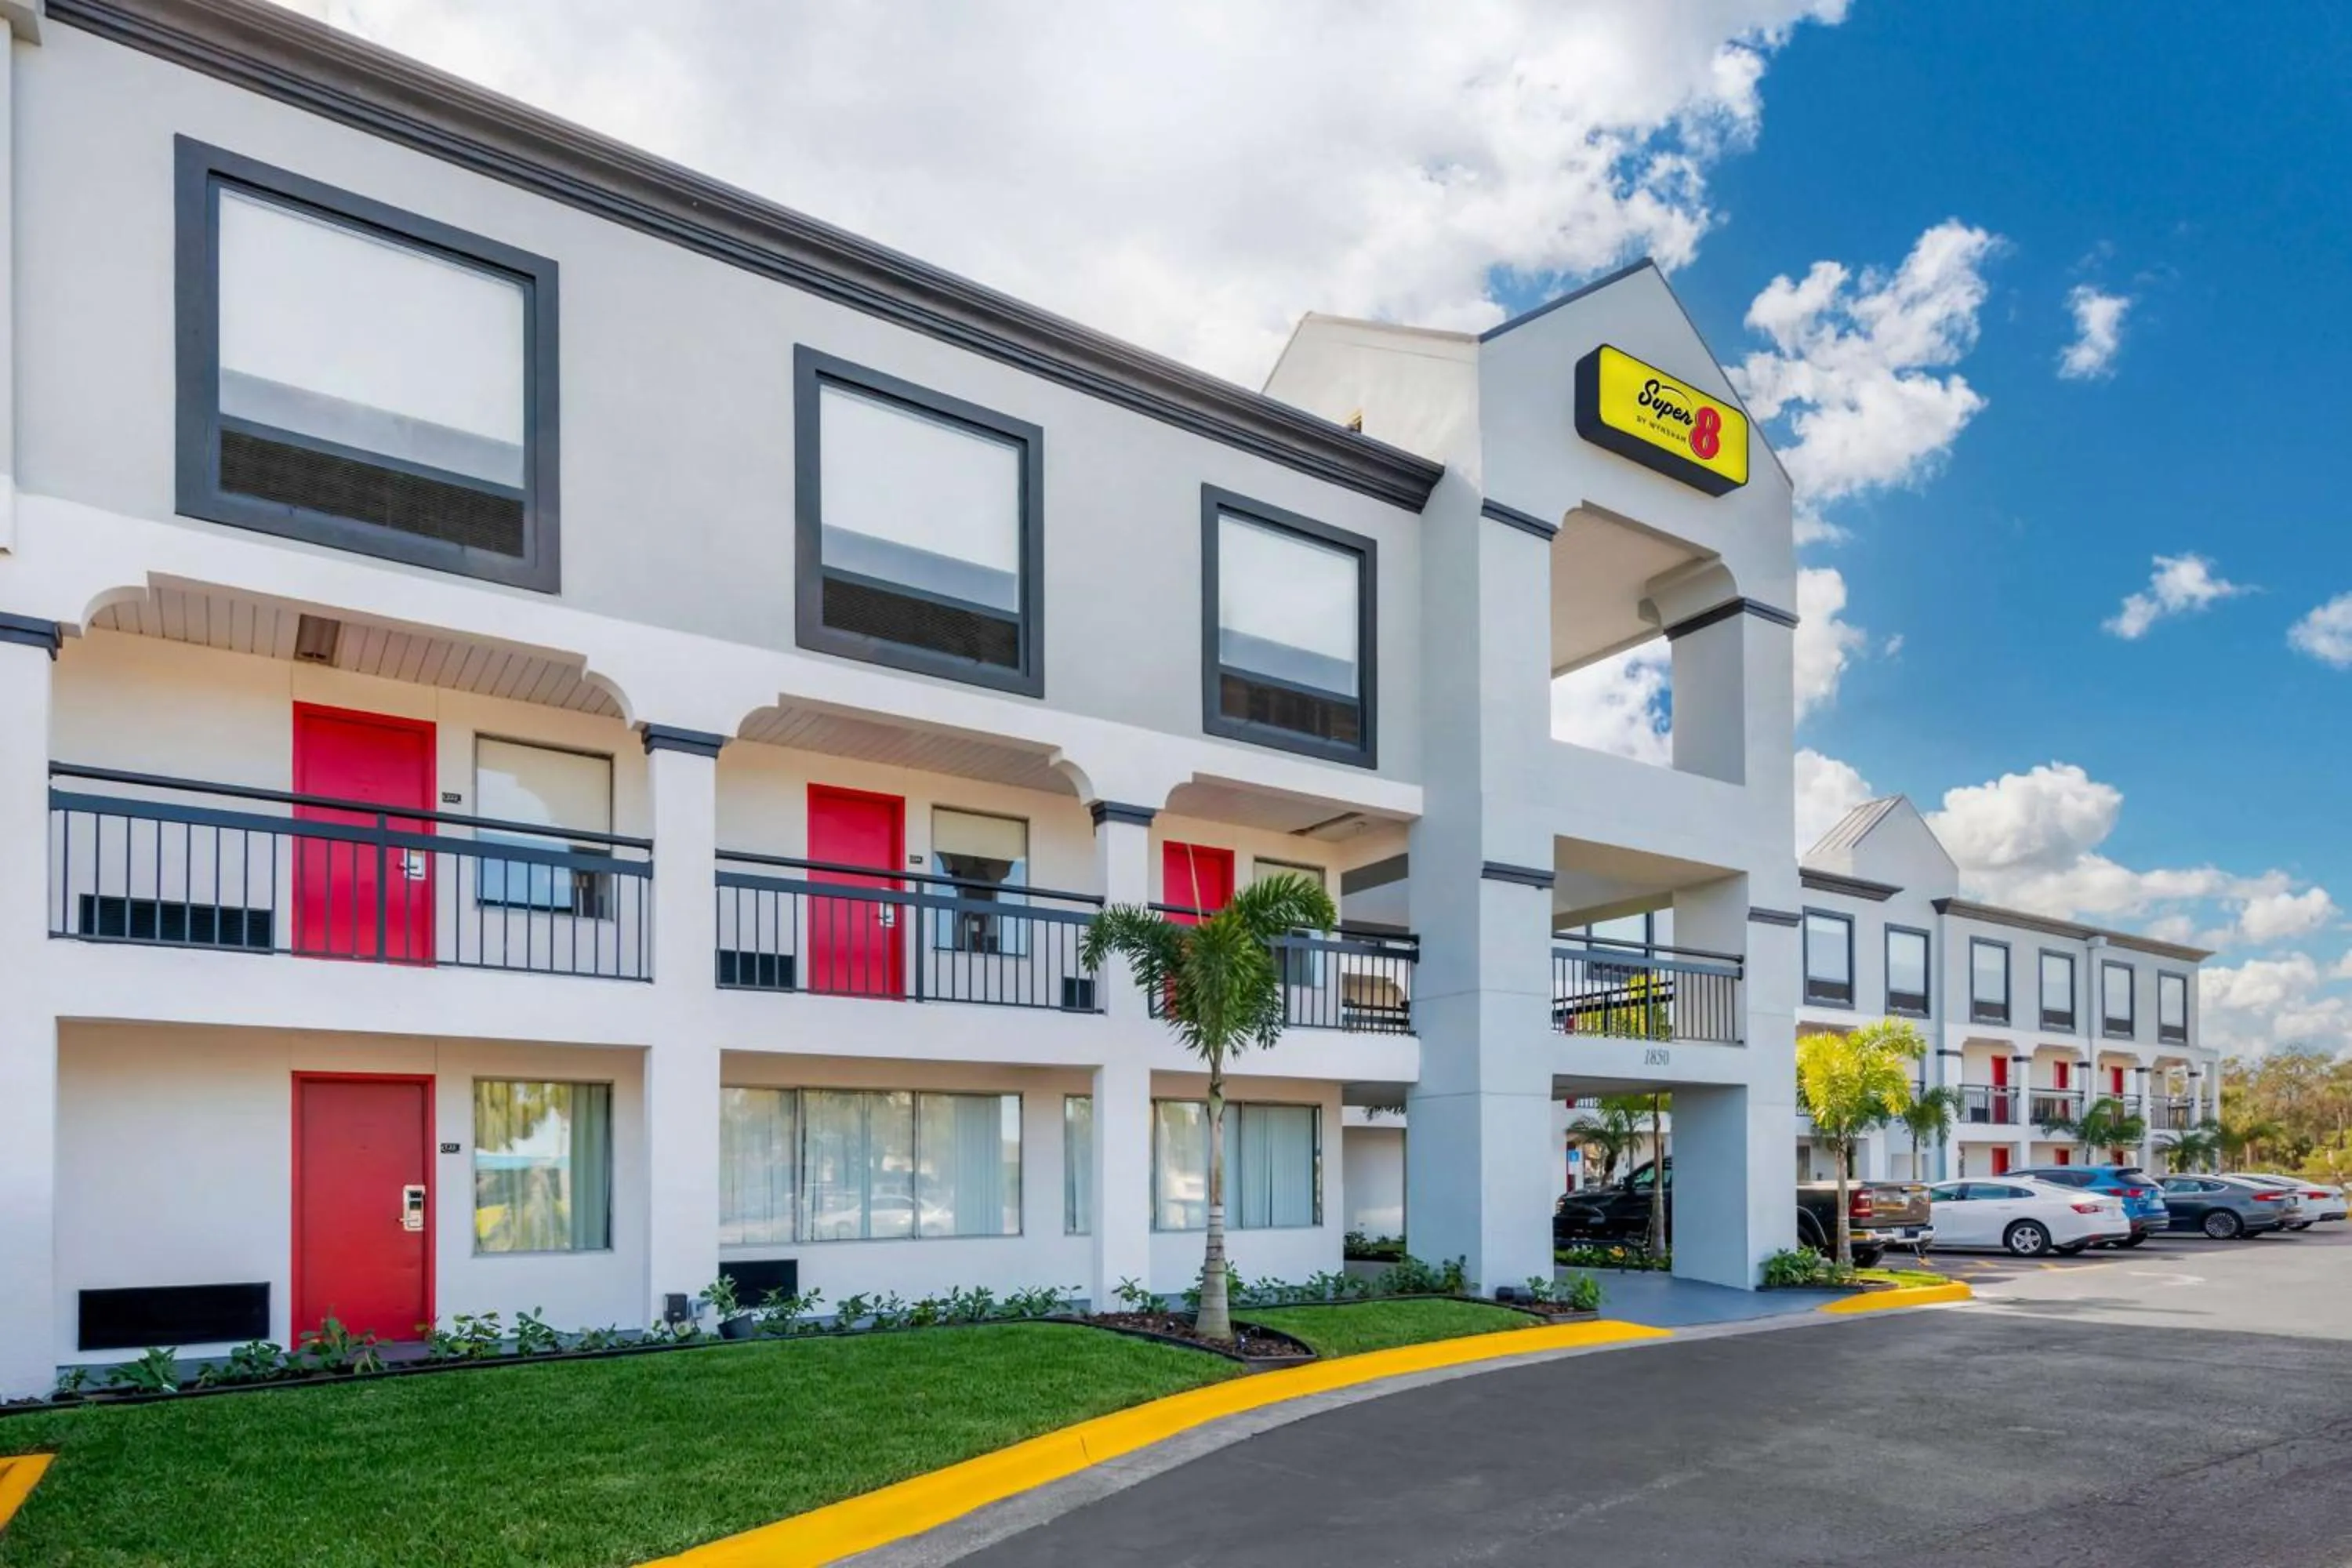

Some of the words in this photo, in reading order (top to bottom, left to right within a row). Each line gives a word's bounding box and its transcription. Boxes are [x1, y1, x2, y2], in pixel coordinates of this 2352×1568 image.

[1636, 415, 1646, 424] BY
[1638, 379, 1693, 426] Super
[1689, 406, 1722, 459] 8
[1644, 1049, 1669, 1065] 1850
